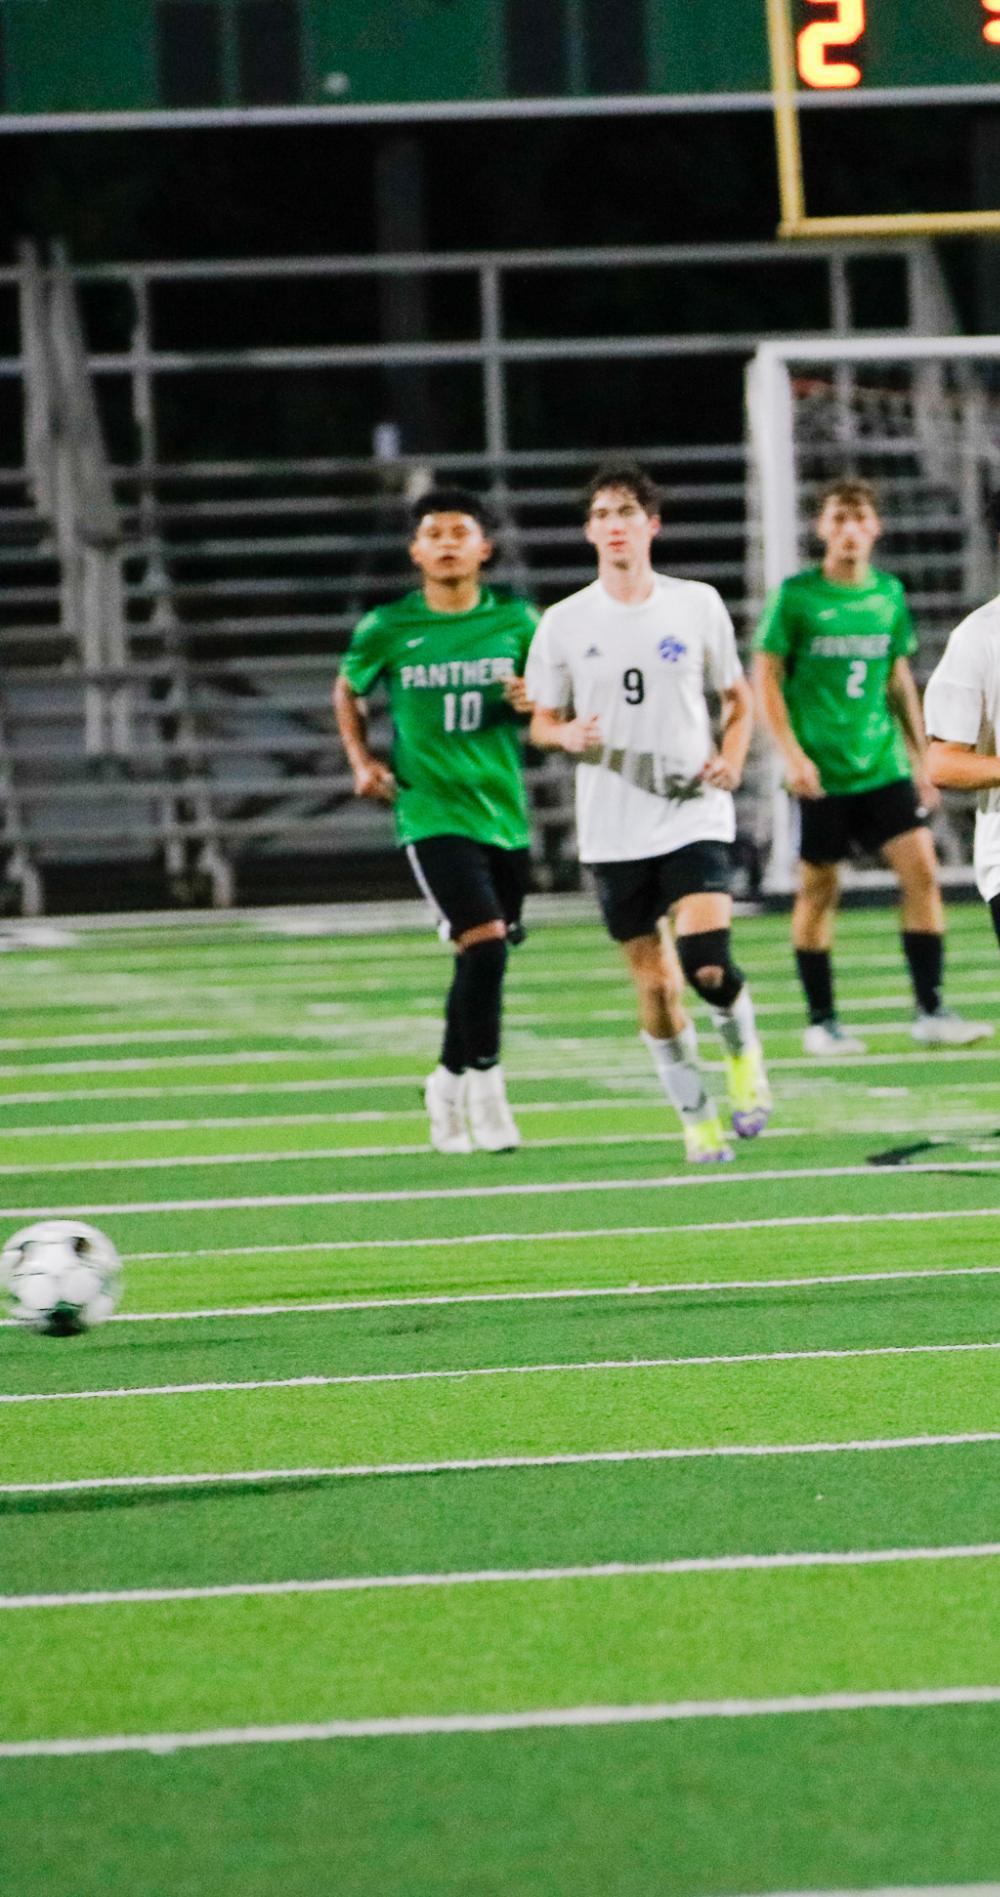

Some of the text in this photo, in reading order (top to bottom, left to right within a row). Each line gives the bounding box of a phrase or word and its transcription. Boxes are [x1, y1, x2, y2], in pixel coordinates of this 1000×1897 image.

[401, 657, 514, 689] PANTHER
[623, 668, 645, 705] 9
[847, 660, 867, 698] 2
[444, 691, 483, 731] 10
